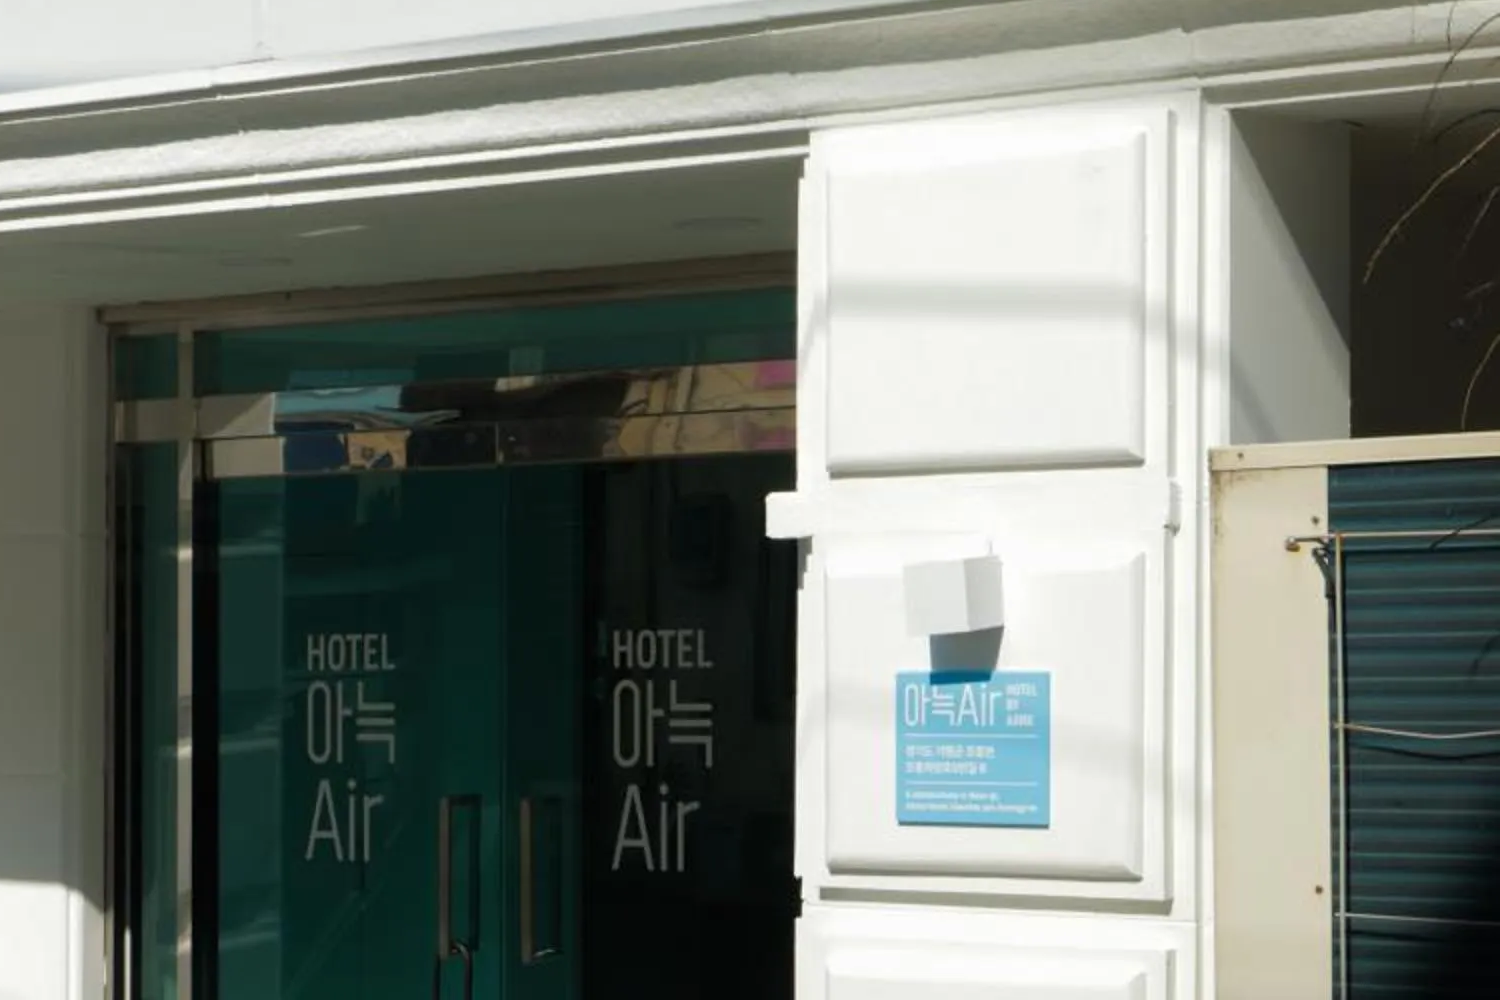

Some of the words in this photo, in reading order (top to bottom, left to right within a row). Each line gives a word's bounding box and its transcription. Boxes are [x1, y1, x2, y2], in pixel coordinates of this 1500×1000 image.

[307, 633, 395, 671] HOTEL
[612, 629, 713, 669] HOTEL
[307, 680, 396, 764] 아늑
[612, 679, 713, 768] 아늑
[305, 779, 384, 862] Air
[611, 783, 700, 872] Air
